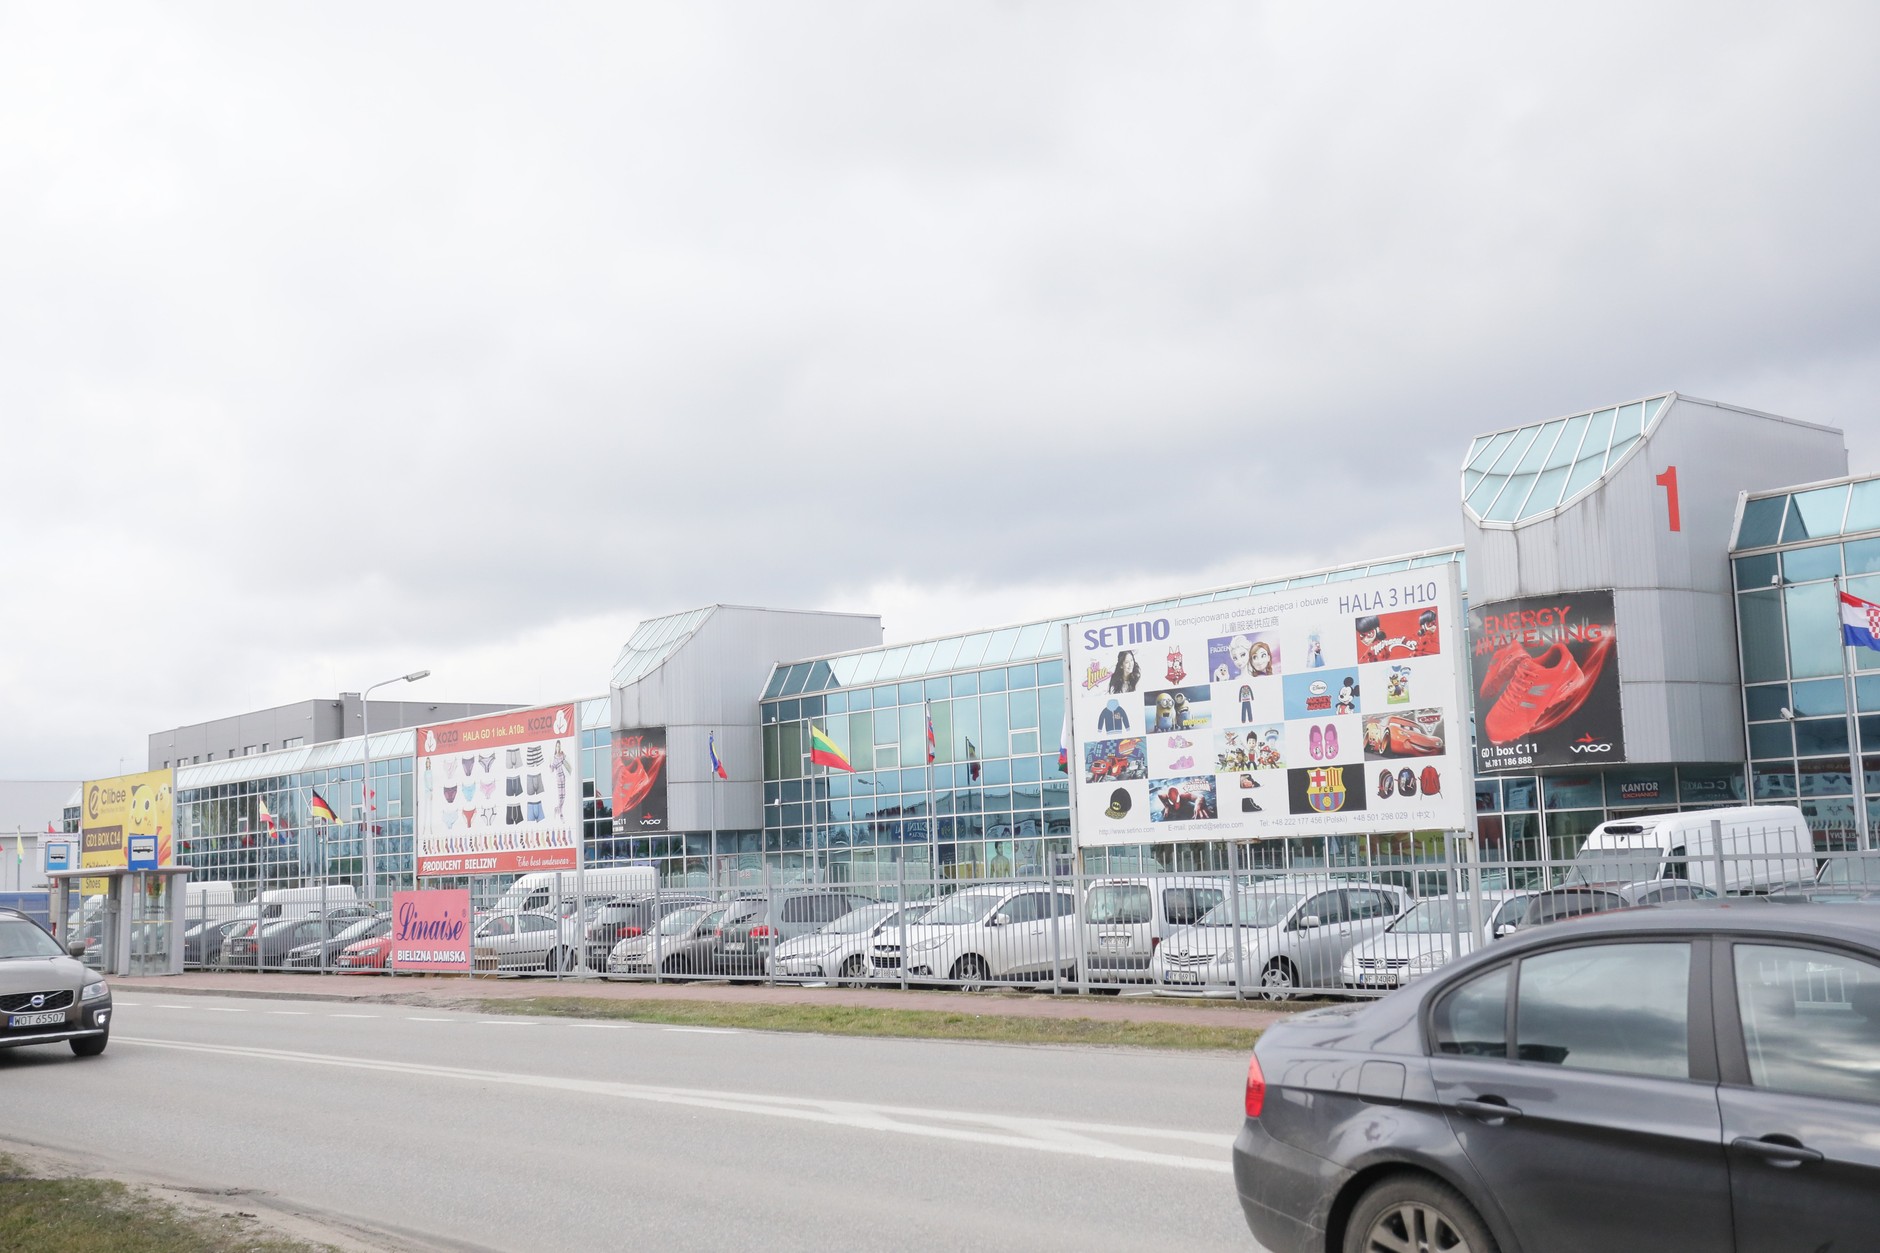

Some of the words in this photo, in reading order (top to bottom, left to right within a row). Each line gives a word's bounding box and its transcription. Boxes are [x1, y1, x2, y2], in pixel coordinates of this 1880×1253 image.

[1656, 465, 1681, 532] 1
[1338, 590, 1384, 615] HALA
[1388, 588, 1398, 607] 3
[1403, 581, 1437, 605] H10
[1174, 611, 1230, 628] licencjonowana
[1231, 606, 1256, 620] odzież
[1257, 601, 1294, 616] dziecięca
[1300, 595, 1329, 609] obuwie
[1484, 605, 1571, 635] ENERGY
[1475, 624, 1603, 657] AWAKENING
[462, 732, 480, 742] HALA
[481, 730, 491, 740] GD
[509, 724, 525, 735] A10a
[1496, 745, 1514, 756] box
[1515, 744, 1523, 754] C
[1504, 757, 1517, 766] 186
[1518, 756, 1532, 765] 888
[1621, 782, 1659, 793] KANTOR
[1622, 790, 1659, 799] EXCHANGE
[1310, 816, 1323, 824] 456
[1324, 815, 1348, 825] (Polski)
[1366, 813, 1379, 821] 501
[1381, 812, 1394, 820] 298
[1395, 811, 1408, 819] 029
[1187, 821, 1244, 832] poland@setino.com
[86, 834, 97, 848] GD1
[98, 832, 109, 846] BOX
[110, 831, 121, 845] C14
[422, 860, 462, 872] PRODUCENT
[465, 857, 497, 869] BIELIZNY
[516, 855, 529, 867] The
[396, 902, 466, 941] Linaise
[397, 950, 432, 962] BIELIZNA
[433, 951, 467, 963] DAMSKA
[36, 1013, 65, 1023] 65507
